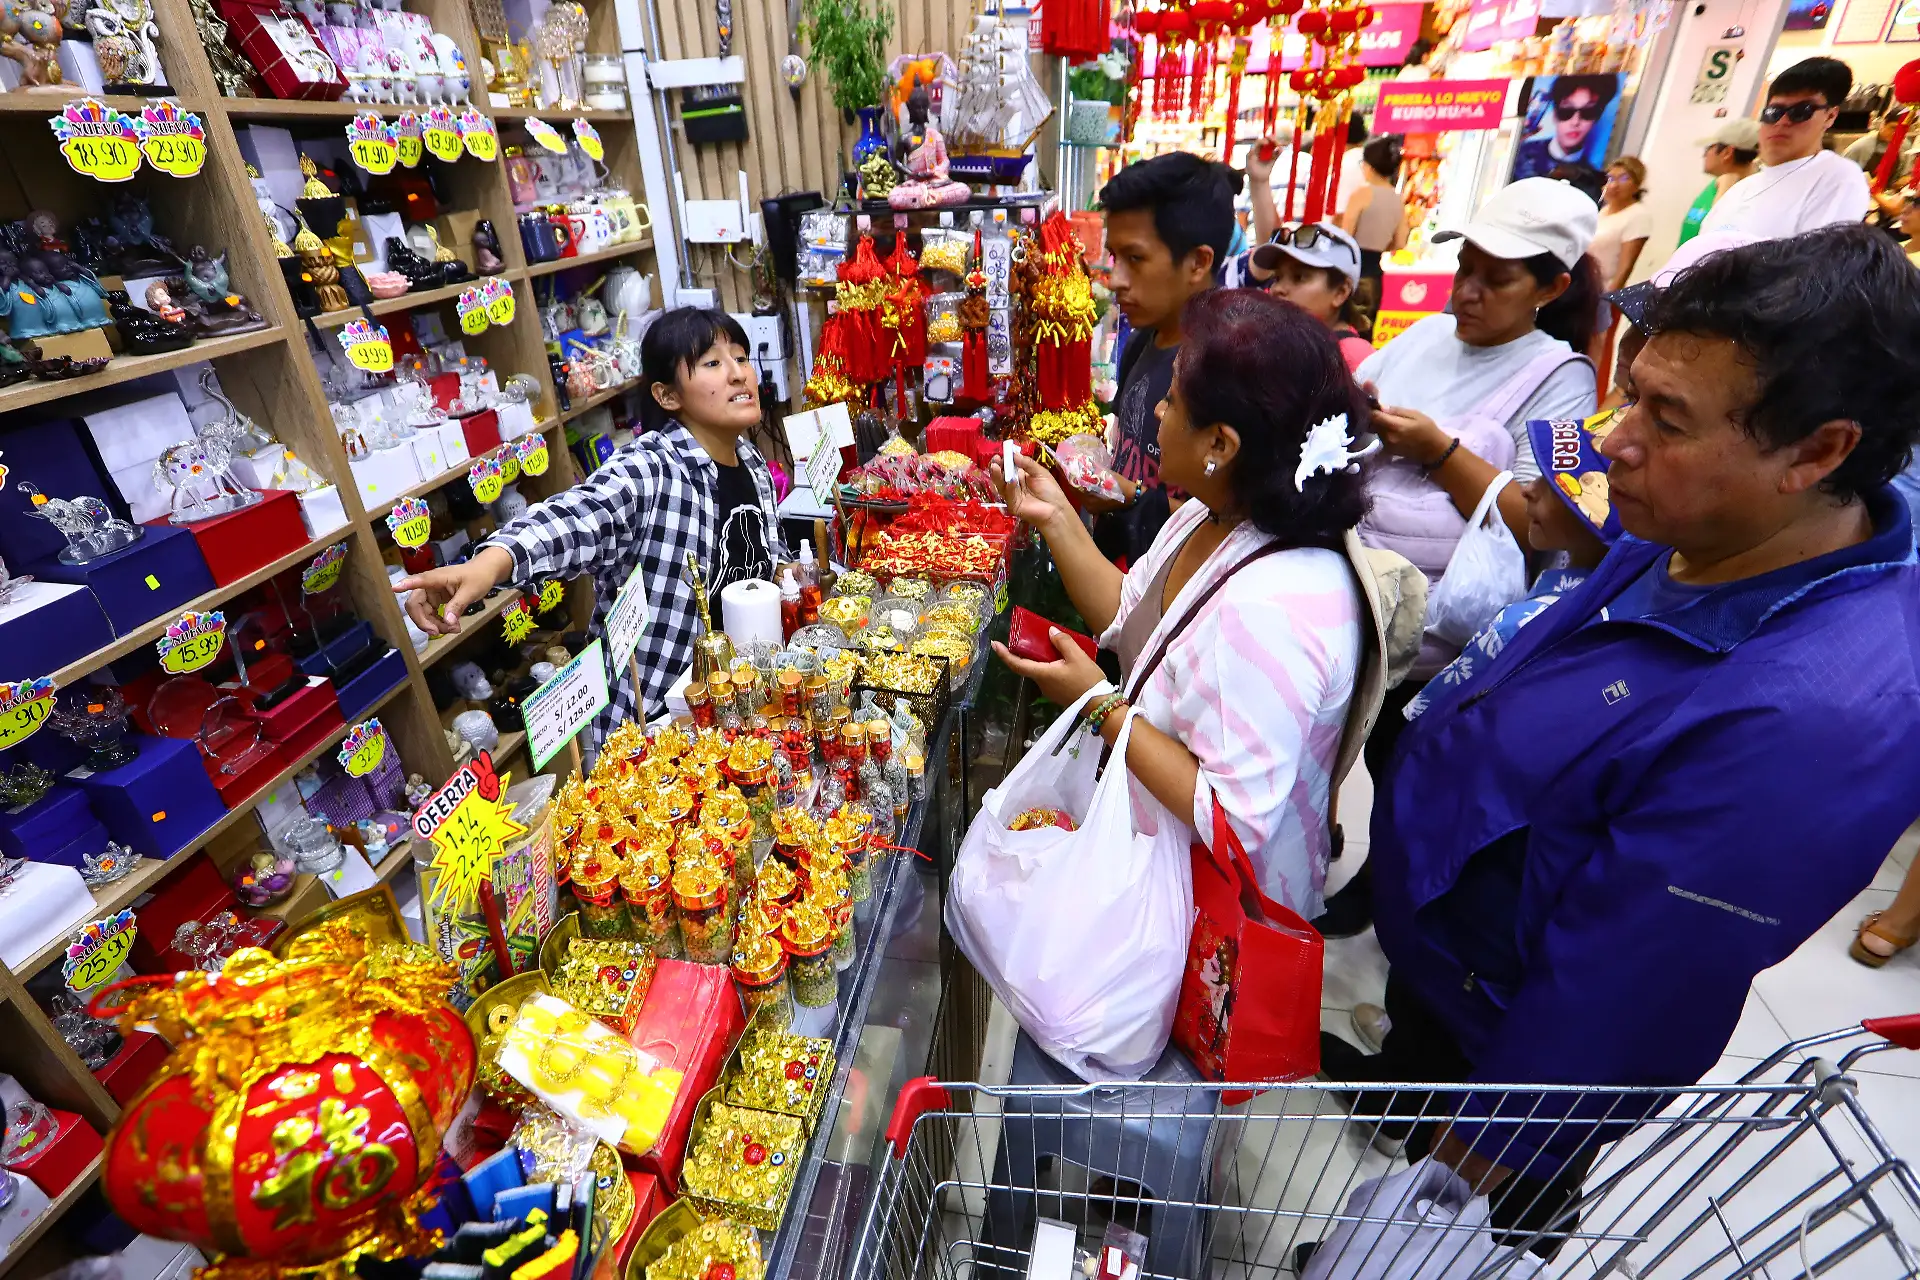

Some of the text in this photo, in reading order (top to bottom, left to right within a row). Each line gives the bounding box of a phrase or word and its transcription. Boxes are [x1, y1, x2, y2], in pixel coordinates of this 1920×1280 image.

[1706, 50, 1732, 79] S
[1435, 92, 1453, 104] LO
[1455, 90, 1502, 104] NUEVO
[70, 121, 123, 136] NUEVO
[149, 120, 192, 134] NUEVO
[357, 144, 389, 164] 11.90
[429, 132, 458, 153] 13.90
[489, 297, 512, 320] 12.90
[358, 347, 389, 365] 9.99
[1550, 418, 1582, 471] BARA
[501, 459, 521, 479] 2.90
[171, 620, 213, 647] NUEVO
[177, 634, 219, 664] 15.99
[0, 689, 36, 714] EVO
[523, 673, 562, 712] ABUNDANCIAS
[565, 683, 588, 712] 12.00
[568, 696, 596, 727] 129.60
[416, 768, 478, 836] OFERTA
[73, 922, 120, 966] NUEVO
[79, 930, 131, 984] 25.90
